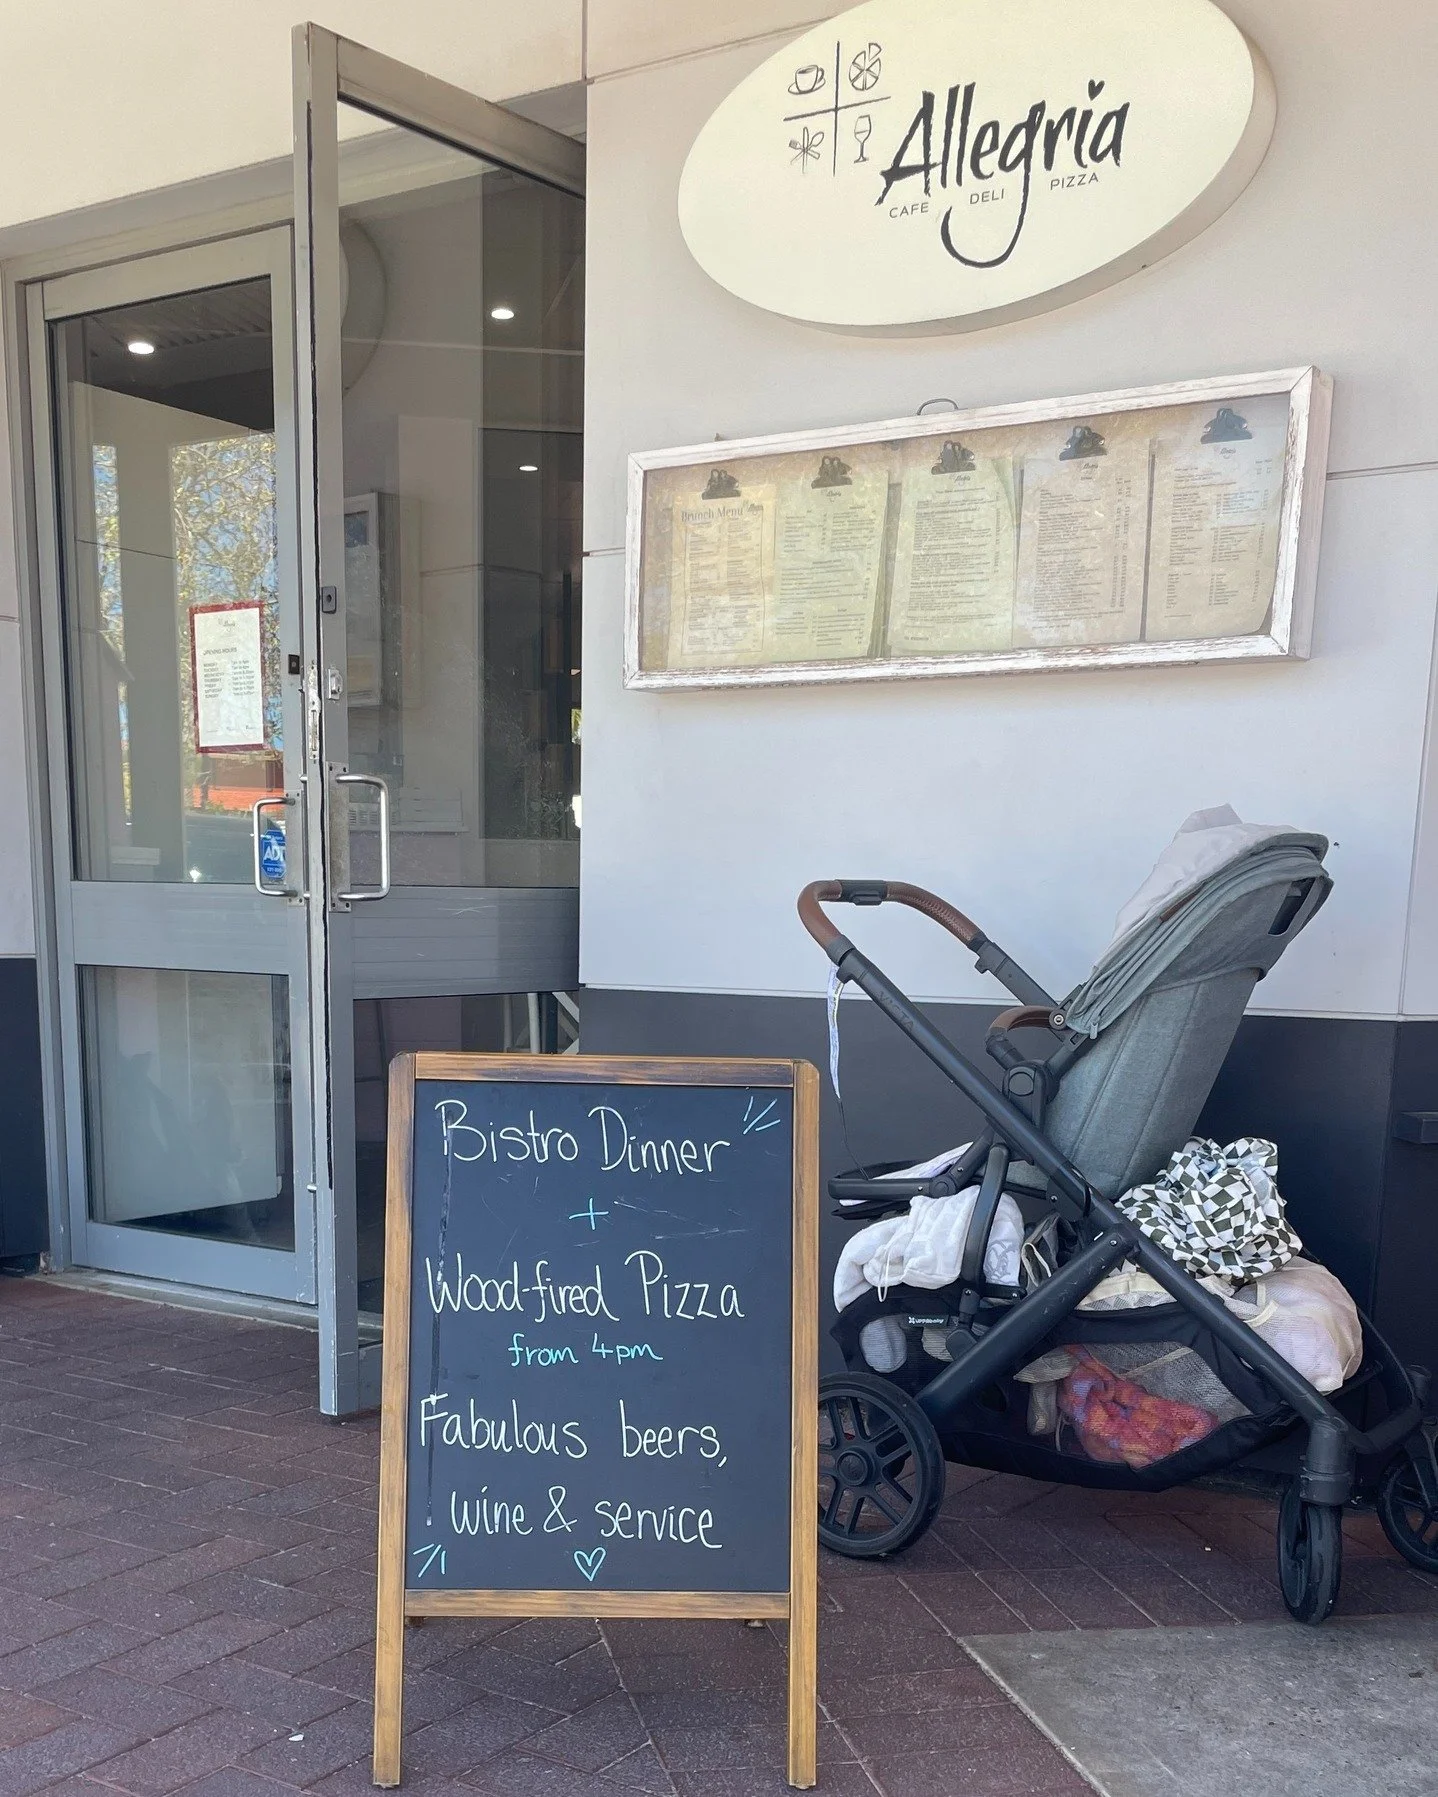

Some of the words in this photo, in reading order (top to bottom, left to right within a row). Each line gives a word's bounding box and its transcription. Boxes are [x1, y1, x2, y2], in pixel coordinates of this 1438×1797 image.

[875, 79, 1130, 268] Allegria
[889, 202, 930, 219] CAFE
[969, 188, 1006, 205] DELI
[1050, 172, 1100, 191] PIZZA
[717, 506, 743, 518] Menu
[263, 845, 286, 862] ADT
[434, 1099, 579, 1163] Bistro
[588, 1105, 731, 1175] Dinner
[425, 1252, 620, 1323] Wood-fired
[624, 1249, 745, 1320] Pizza
[508, 1332, 579, 1367] from
[591, 1332, 663, 1366] 4pm
[420, 1393, 588, 1459] Fabulous
[619, 1399, 728, 1468] beers,
[542, 1485, 578, 1533] &
[594, 1500, 722, 1550] service
